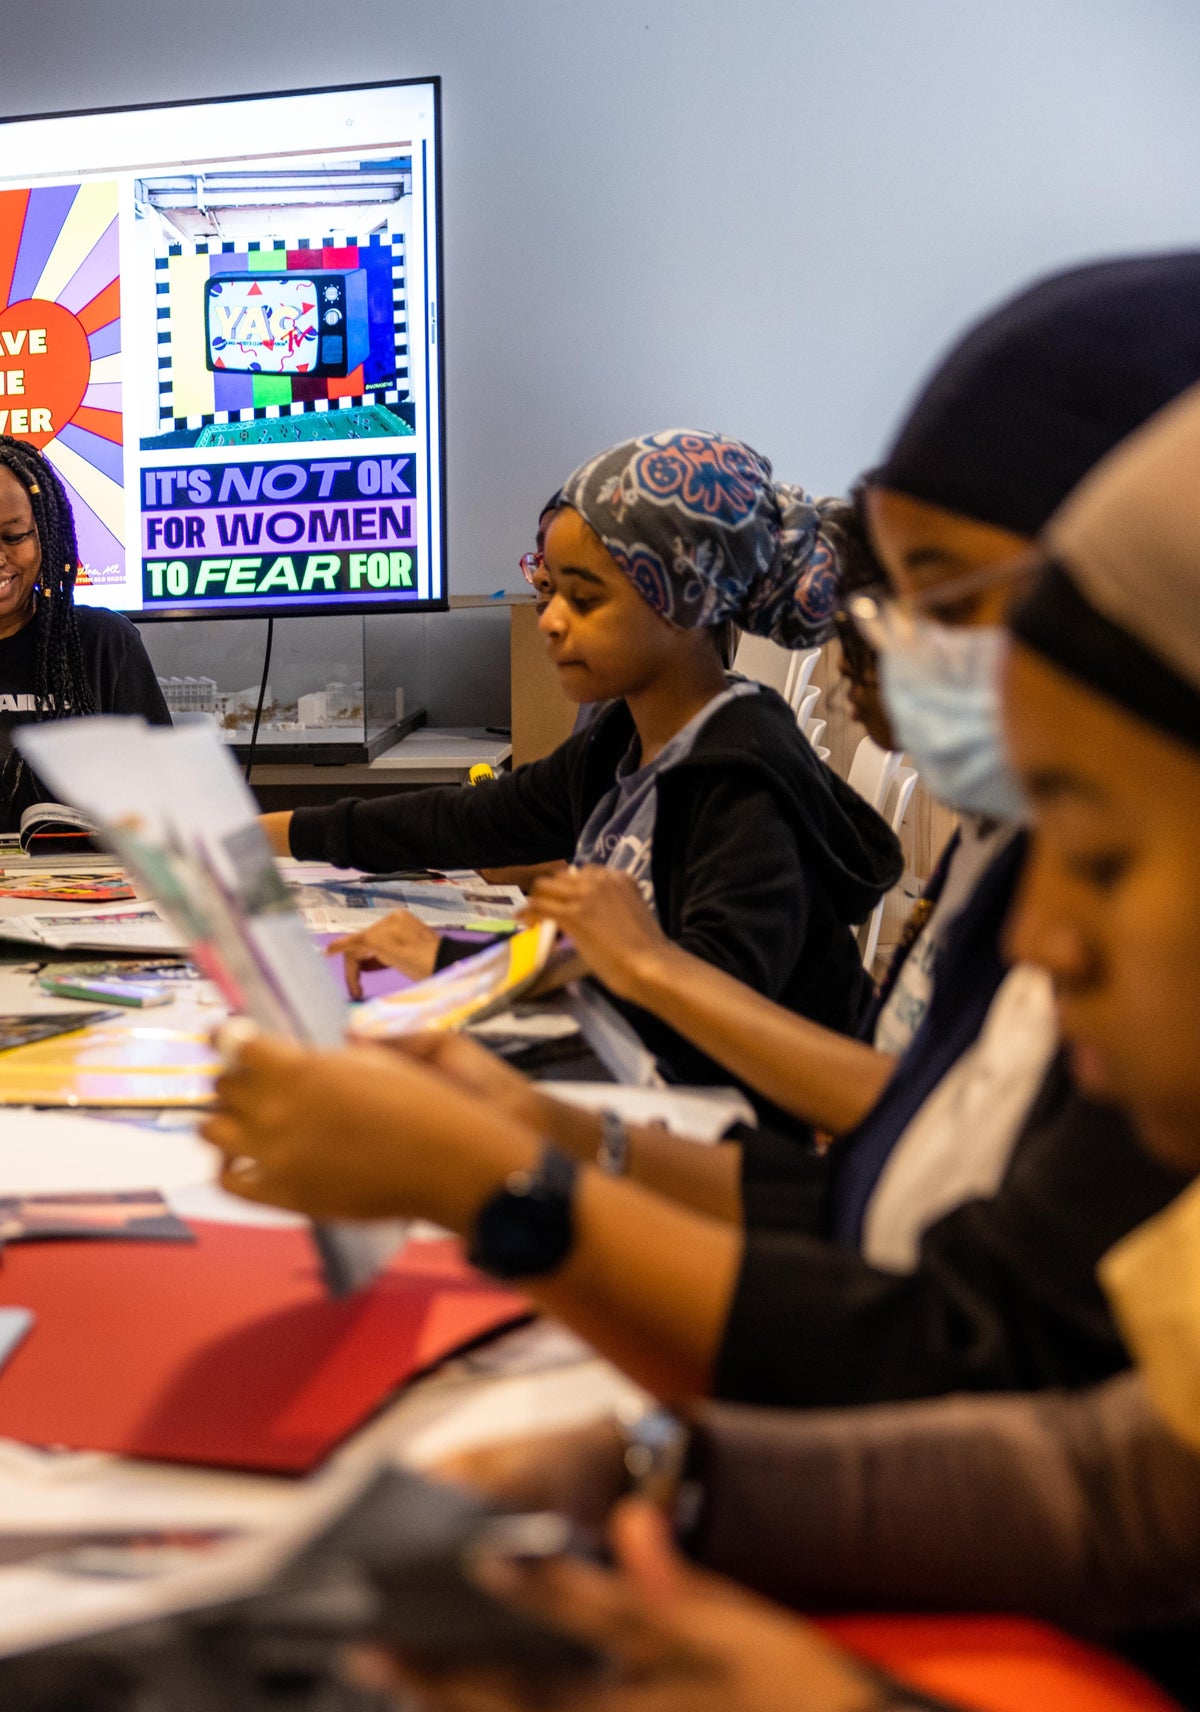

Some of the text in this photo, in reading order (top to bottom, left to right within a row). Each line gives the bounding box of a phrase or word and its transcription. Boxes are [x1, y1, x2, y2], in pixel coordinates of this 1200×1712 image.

[215, 305, 303, 340] YAC
[145, 458, 412, 506] IT'S NOT OK
[146, 505, 412, 550] FOR WOMEN
[146, 551, 413, 597] TO FEAR FOR
